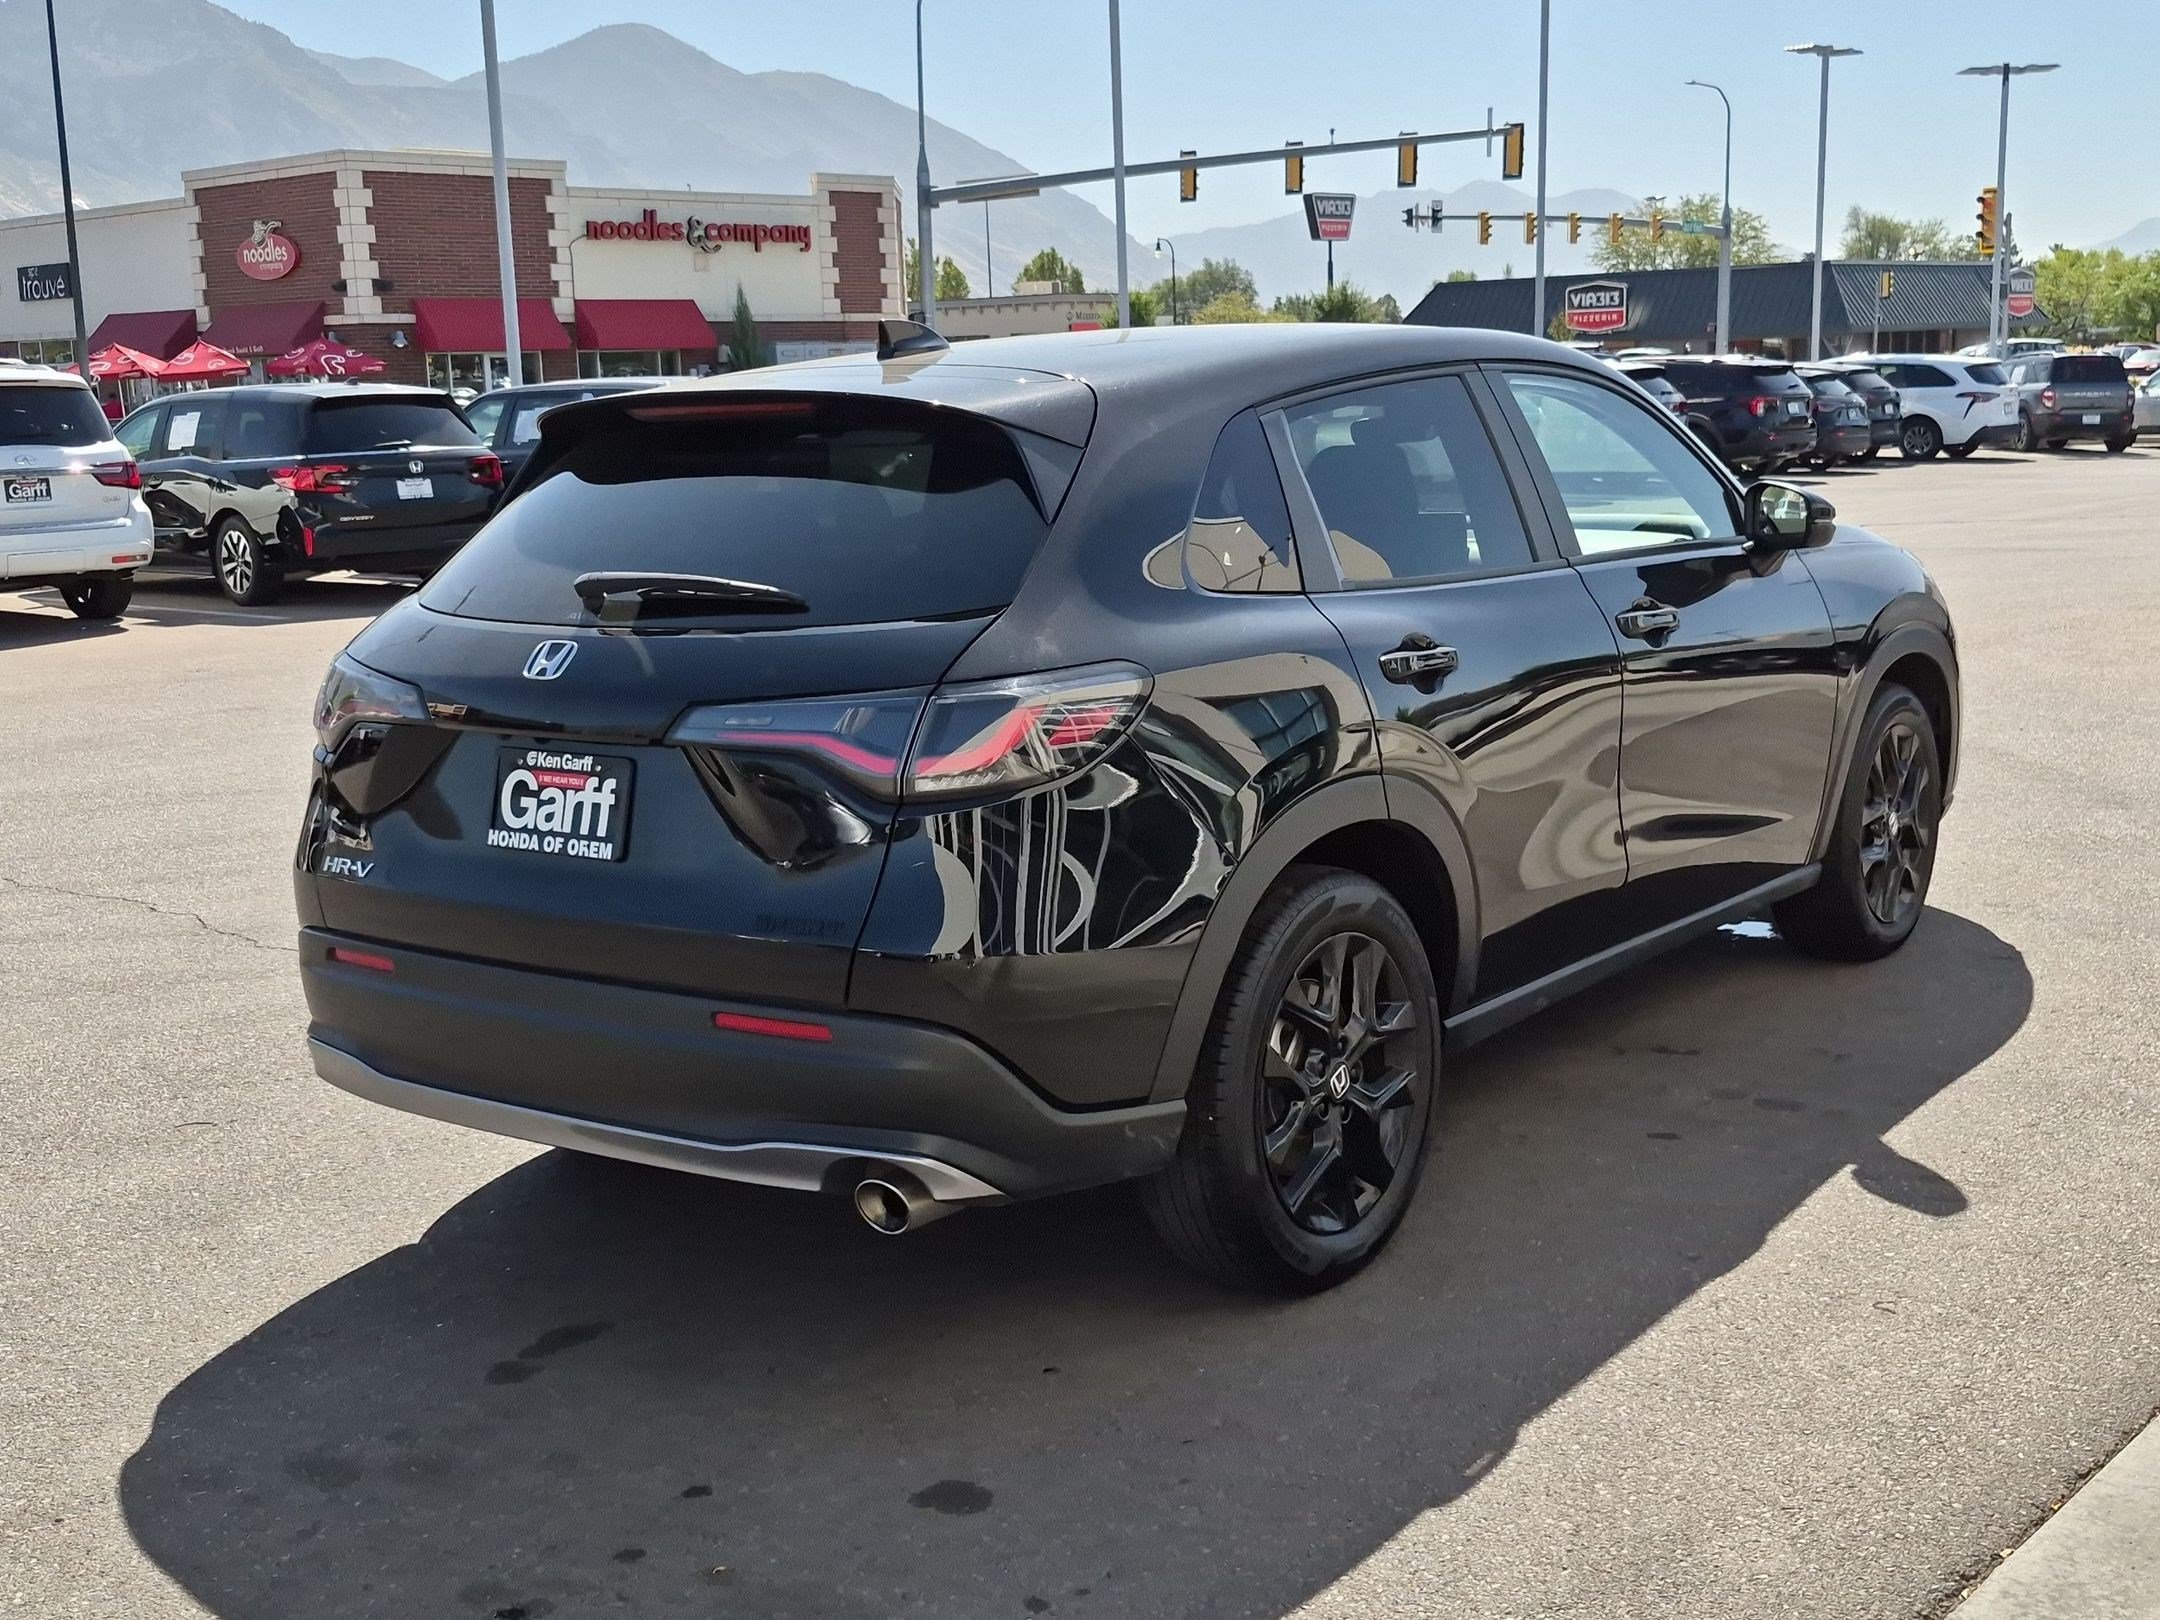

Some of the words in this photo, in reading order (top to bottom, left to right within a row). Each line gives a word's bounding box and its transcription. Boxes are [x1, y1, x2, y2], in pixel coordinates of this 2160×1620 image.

[586, 208, 684, 241] noodles
[704, 222, 812, 252] company
[243, 237, 287, 263] noodles
[9, 483, 47, 498] Garff
[537, 751, 561, 769] Ken
[562, 753, 594, 772] Garff
[553, 776, 567, 786] HEAR
[568, 777, 580, 787] YOU
[501, 768, 617, 838] Garff
[487, 828, 539, 851] HONDA
[543, 836, 565, 854] OF
[567, 838, 613, 860] OREM
[323, 855, 375, 878] HR-V
